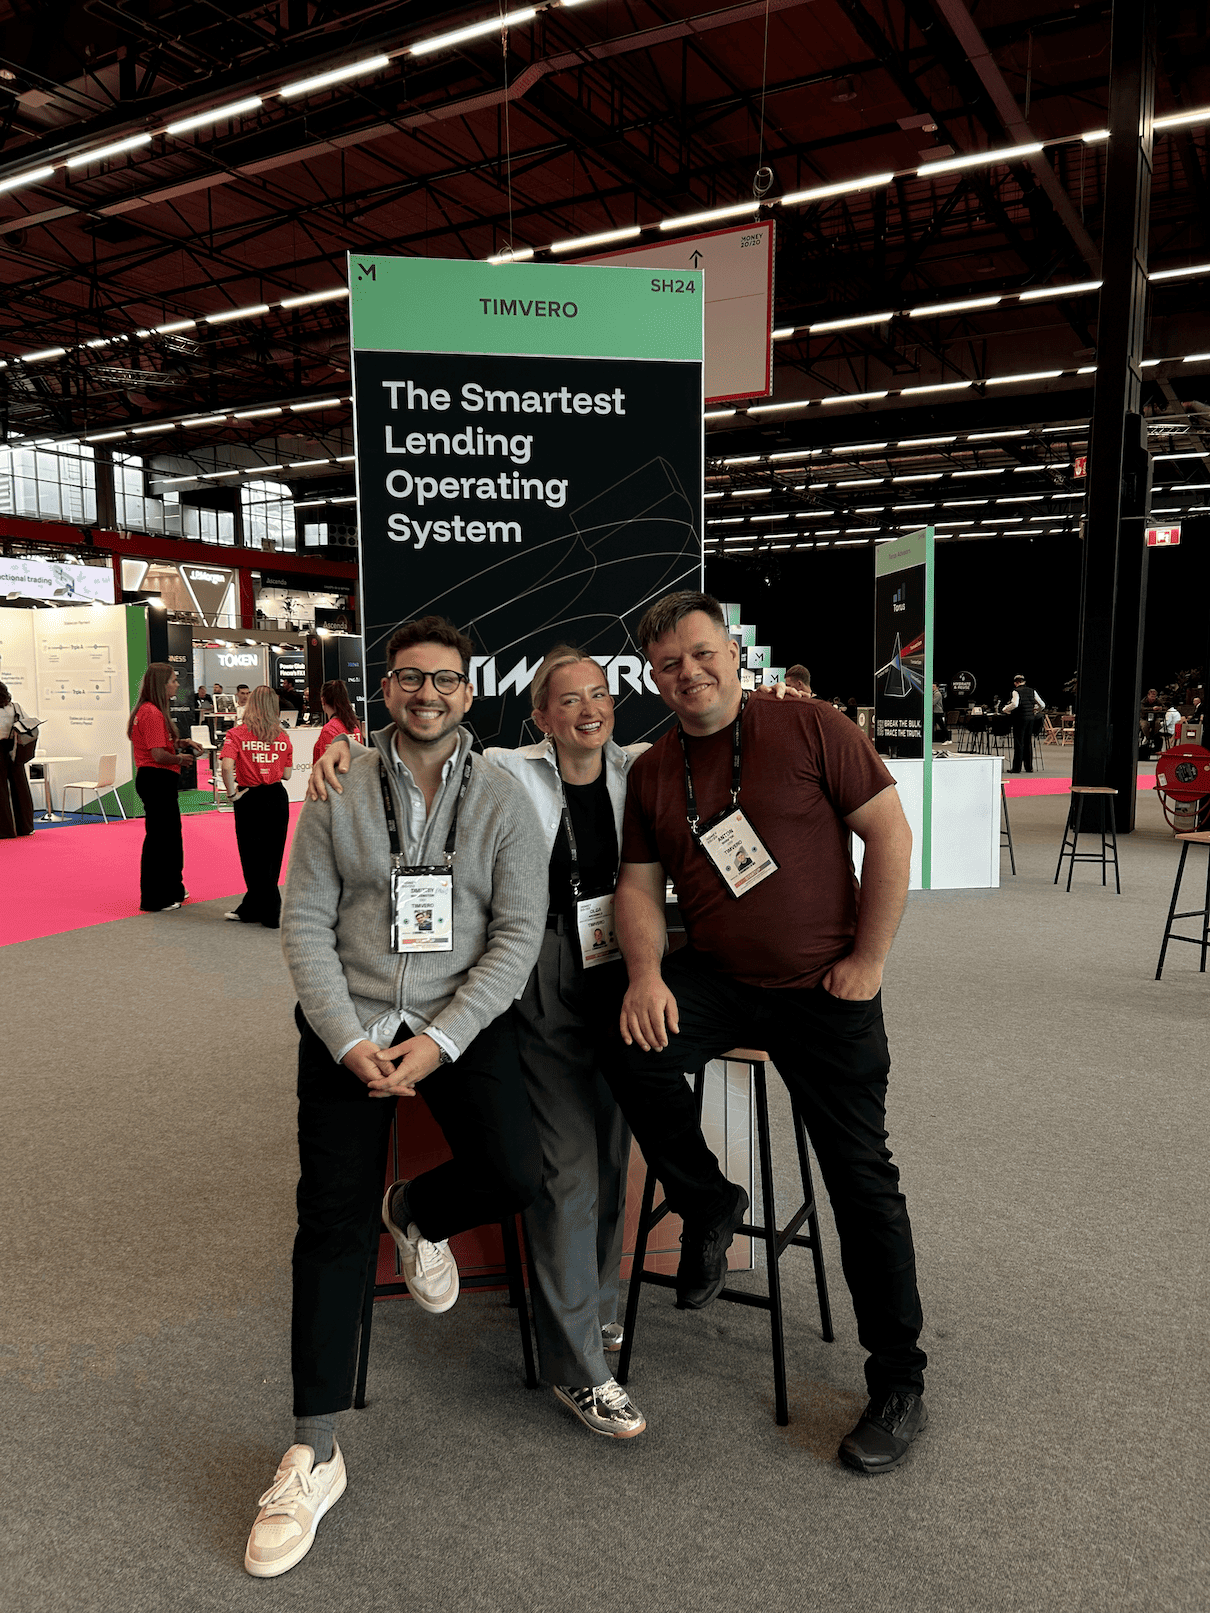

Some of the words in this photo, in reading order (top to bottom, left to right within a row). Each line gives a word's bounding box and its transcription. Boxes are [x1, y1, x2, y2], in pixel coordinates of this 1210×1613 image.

[741, 233, 763, 242] MONEY
[740, 239, 761, 248] 20/20
[651, 279, 696, 294] SH24
[479, 298, 579, 318] TIMVERO
[382, 380, 451, 411] The
[461, 382, 626, 415] Smartest
[385, 425, 534, 465] Lending
[385, 469, 569, 508] Operating
[387, 513, 523, 549] System
[27, 576, 52, 586] trading
[266, 577, 287, 586] Ascenda
[893, 603, 906, 612] Torus
[322, 620, 348, 631] Ascenda
[217, 653, 258, 667] TOKEN
[884, 720, 898, 728] BREAK
[899, 720, 908, 728] THE
[909, 720, 922, 728] BULK.
[884, 729, 898, 737] TRACE
[898, 729, 907, 737] THE
[907, 729, 922, 738] TRUTH.
[241, 740, 271, 751] HERE
[274, 741, 288, 752] TO
[252, 753, 279, 763] HELP
[724, 840, 743, 854] TIMVERO
